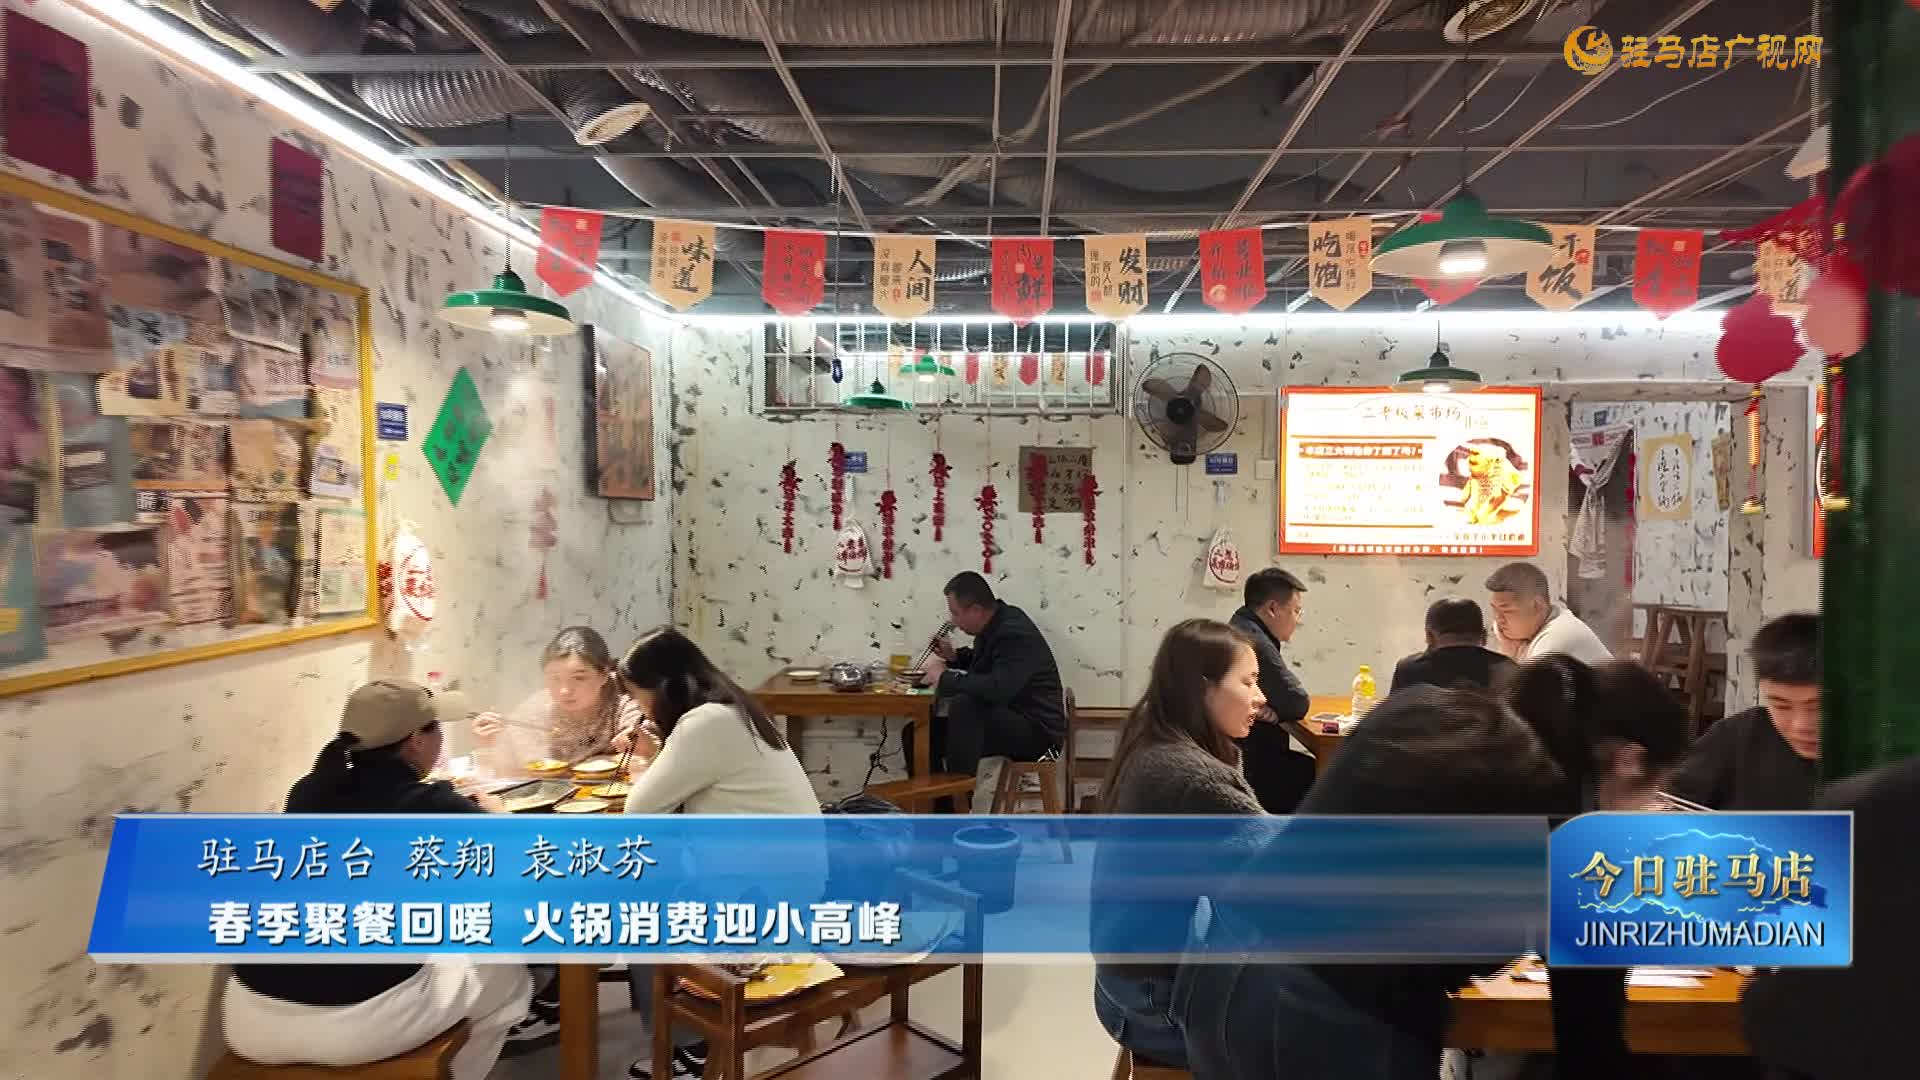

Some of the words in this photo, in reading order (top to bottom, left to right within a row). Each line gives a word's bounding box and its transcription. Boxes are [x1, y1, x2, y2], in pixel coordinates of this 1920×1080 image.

[672, 233, 711, 294] 味道
[905, 247, 933, 303] 人间
[1118, 245, 1145, 306] 发财
[1312, 229, 1343, 291] 吃饱
